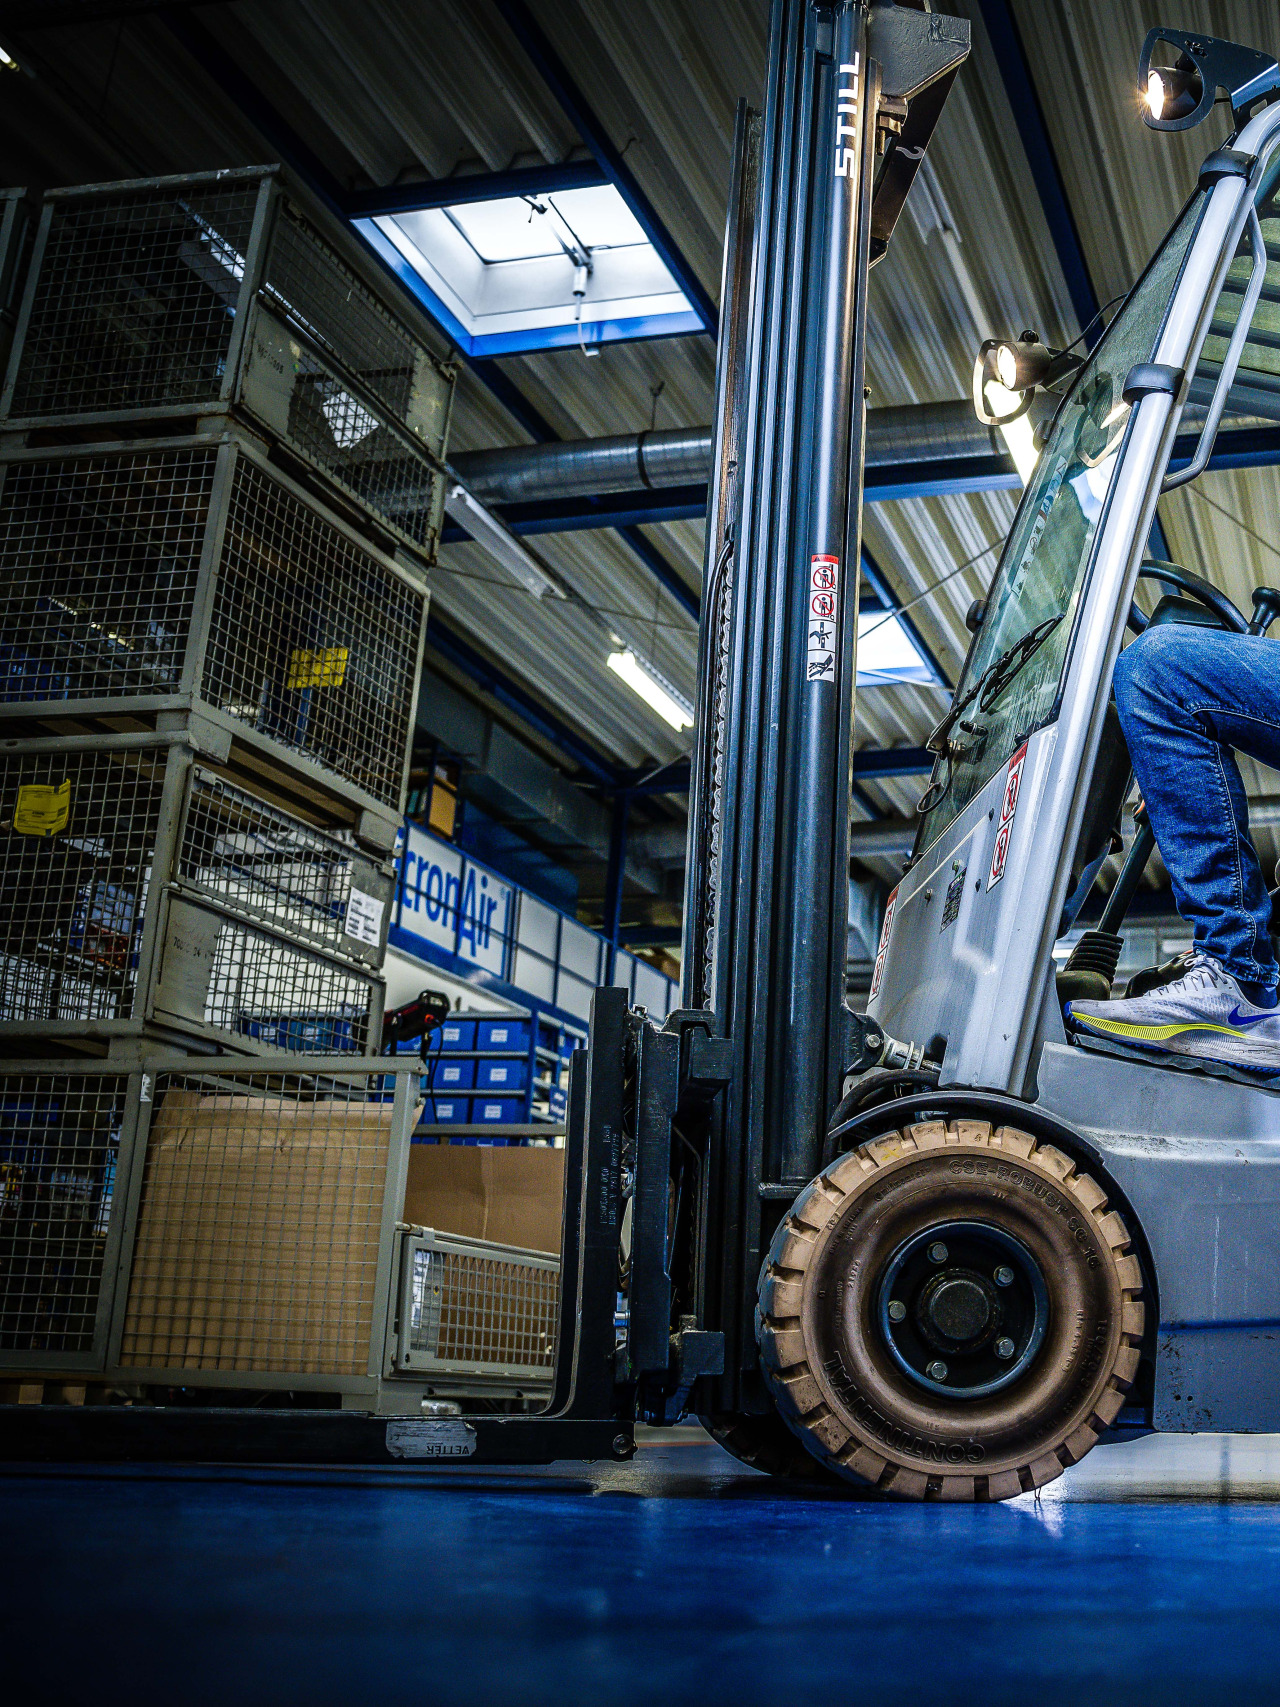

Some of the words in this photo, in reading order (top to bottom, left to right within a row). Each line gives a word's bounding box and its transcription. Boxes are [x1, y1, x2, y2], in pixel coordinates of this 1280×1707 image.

[834, 51, 860, 179] STILL
[949, 1159, 1069, 1215] CSE-ROBUST
[823, 1350, 986, 1464] CONTINENTAL
[426, 1445, 470, 1455] VETTER
